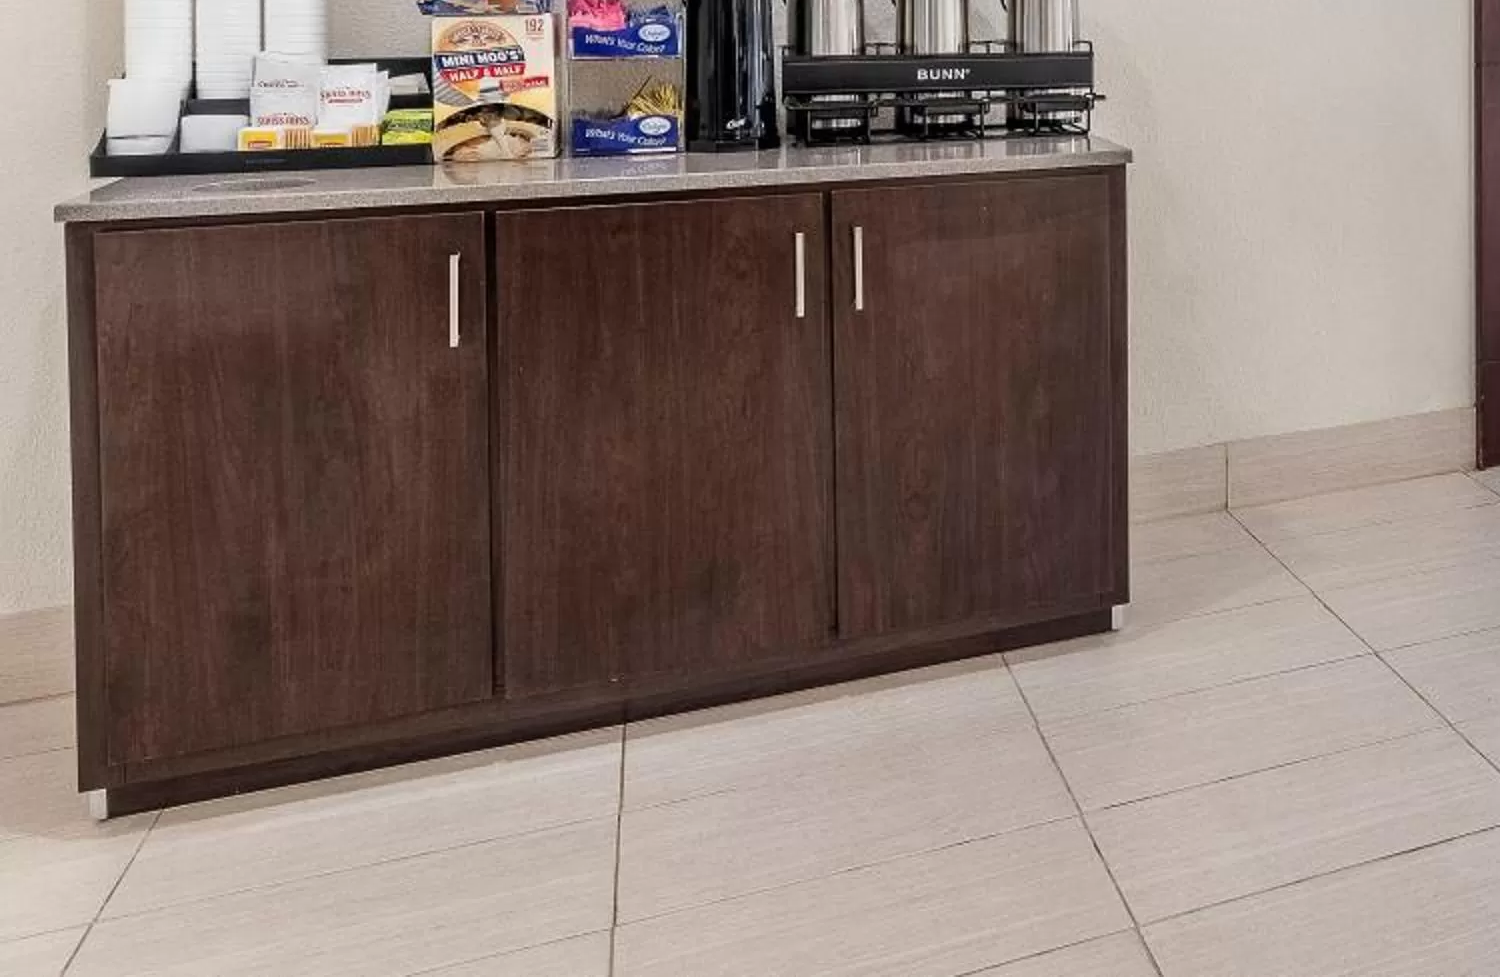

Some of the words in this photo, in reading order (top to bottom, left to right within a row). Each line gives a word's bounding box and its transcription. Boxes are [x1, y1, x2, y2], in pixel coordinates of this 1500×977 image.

[525, 19, 545, 32] 192
[617, 38, 637, 50] Your
[441, 54, 475, 67] MINI
[477, 49, 519, 64] MOO'S
[448, 68, 480, 82] HALF
[494, 65, 523, 76] HALF
[917, 68, 965, 80] BUNN
[617, 132, 637, 144] Your
